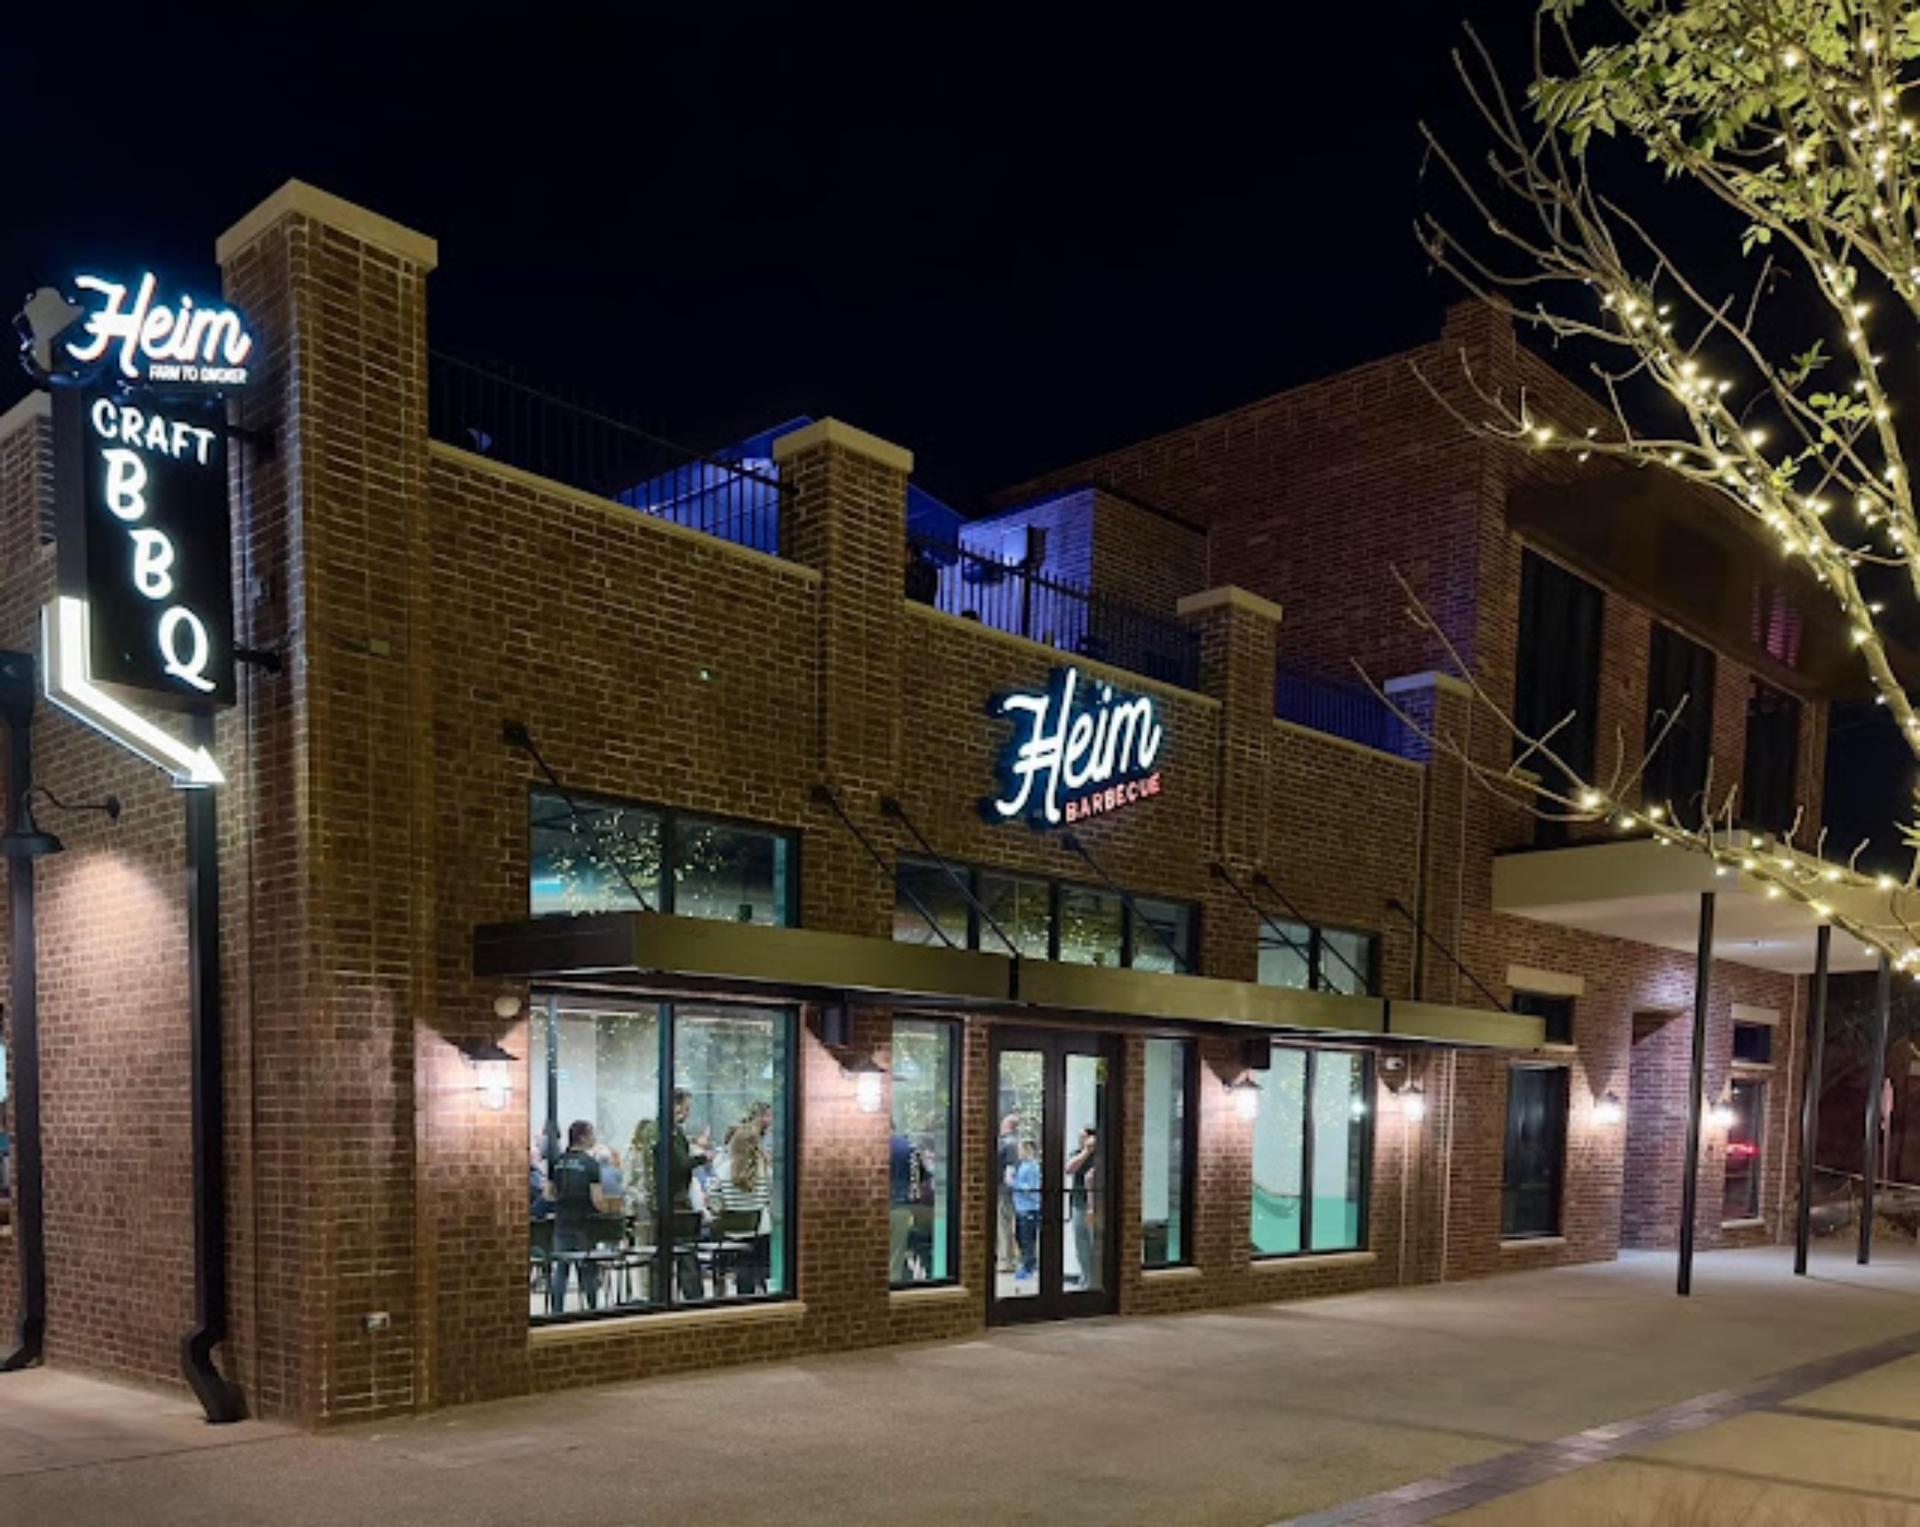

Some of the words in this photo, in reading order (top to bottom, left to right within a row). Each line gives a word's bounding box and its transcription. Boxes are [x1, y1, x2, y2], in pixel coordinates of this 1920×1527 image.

[66, 271, 252, 378] Heim
[182, 365, 198, 381] TO
[92, 398, 216, 465] CRAFT
[995, 667, 1162, 823] Heim
[1065, 772, 1162, 823] BARBECUE
